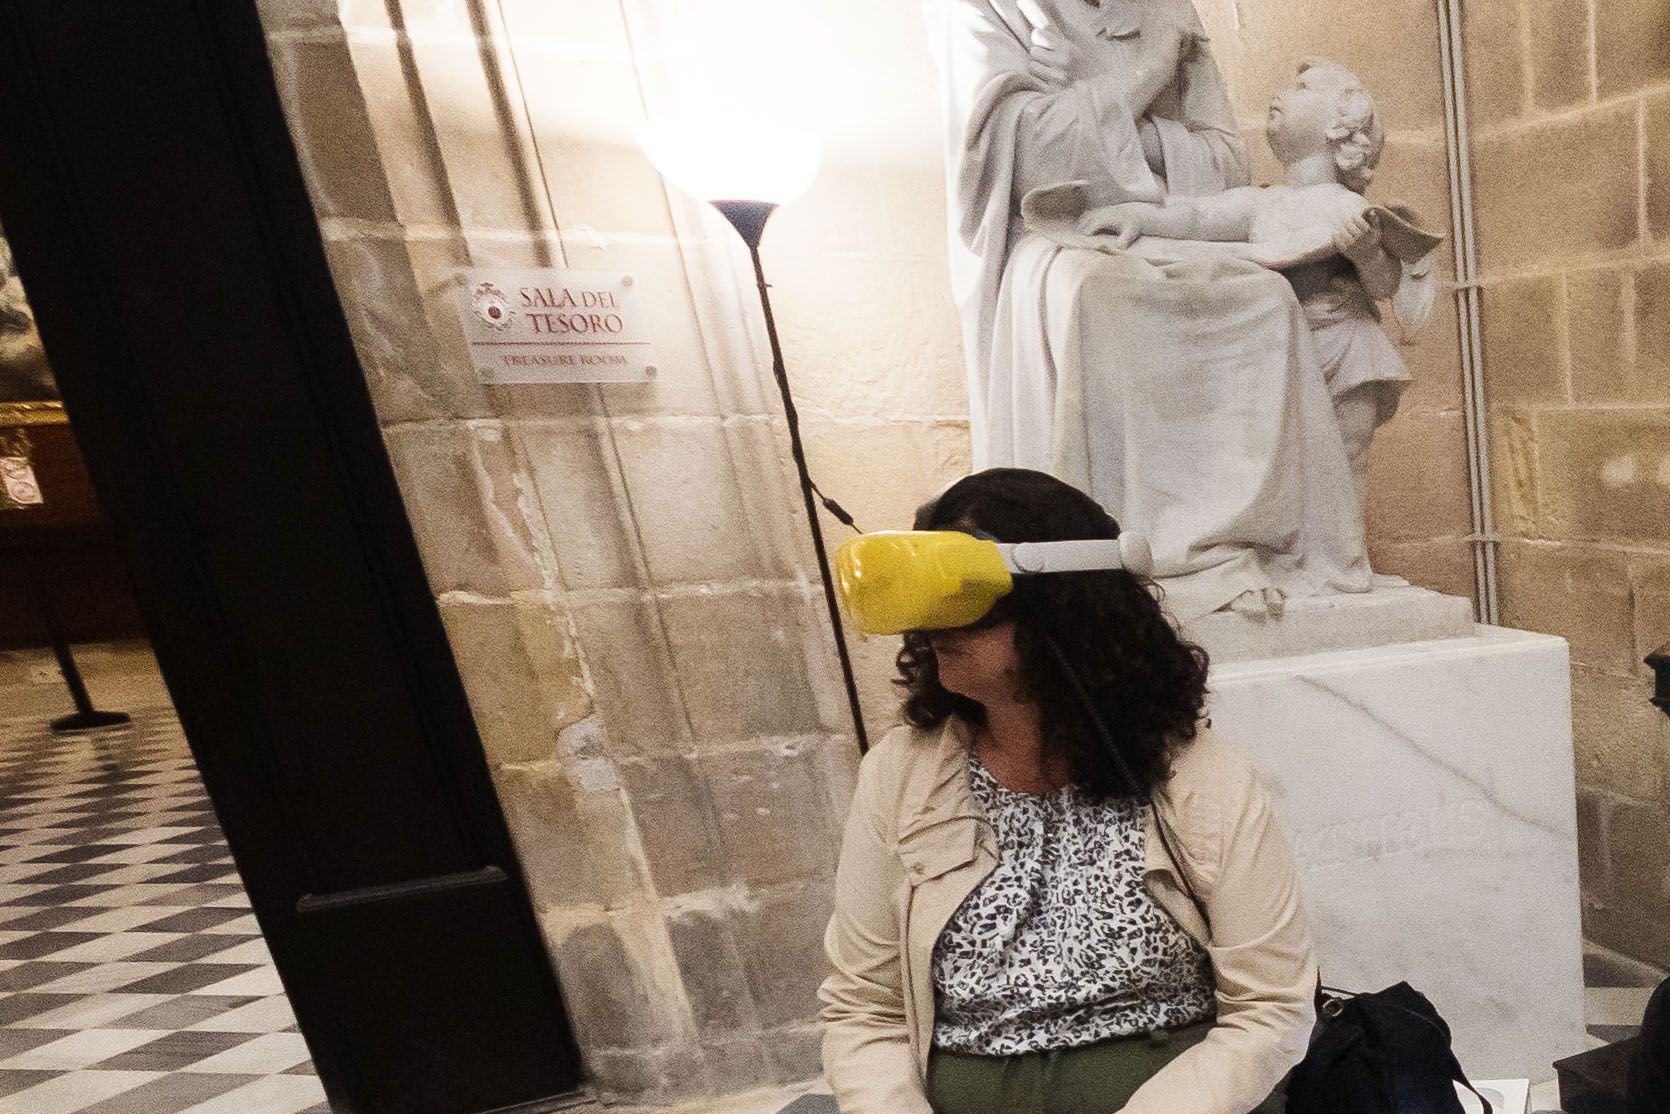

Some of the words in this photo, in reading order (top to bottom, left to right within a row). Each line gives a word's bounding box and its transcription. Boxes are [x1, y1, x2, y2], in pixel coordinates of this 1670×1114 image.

[519, 288, 576, 308] SALA
[582, 291, 619, 308] DEL
[526, 313, 624, 334] TESORO
[502, 354, 577, 366] TREASURE
[581, 354, 628, 366] ROOM
